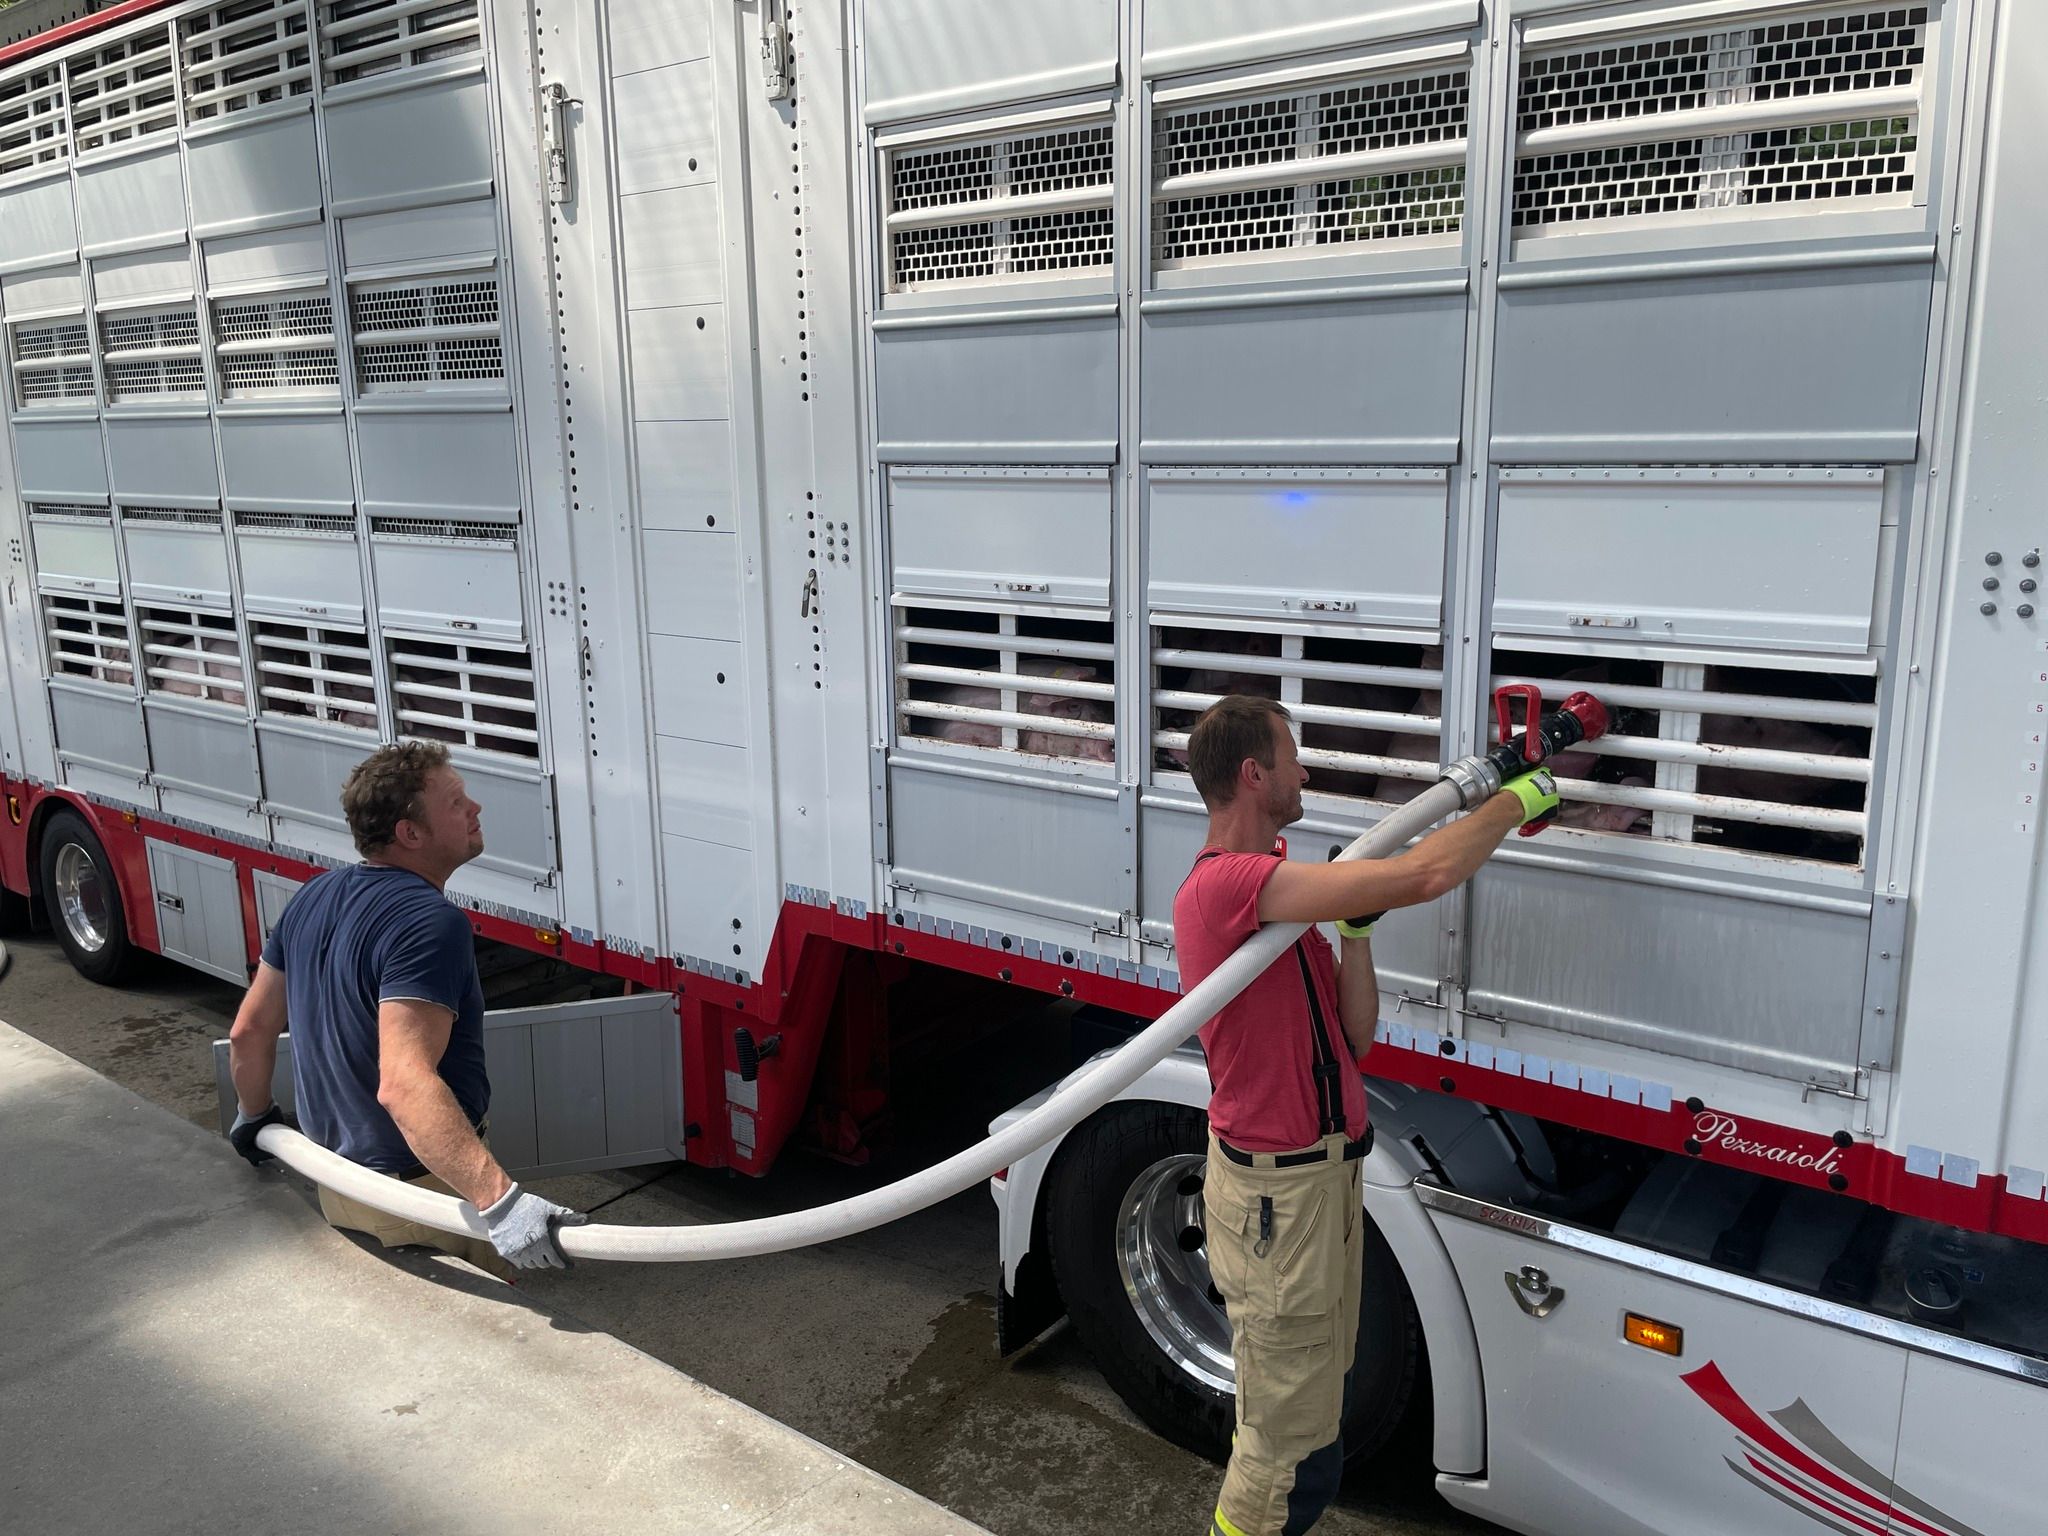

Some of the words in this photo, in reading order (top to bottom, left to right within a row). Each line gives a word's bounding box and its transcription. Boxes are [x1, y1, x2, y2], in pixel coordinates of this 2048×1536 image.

[2040, 672, 2047, 682] 6
[2036, 704, 2043, 713] 5
[2032, 734, 2040, 743] 4
[2029, 762, 2036, 771] 3
[2025, 795, 2032, 804] 2
[2021, 823, 2026, 832] 1
[1693, 1111, 1845, 1175] Pezzaioli
[1479, 1206, 1540, 1235] SCANIA
